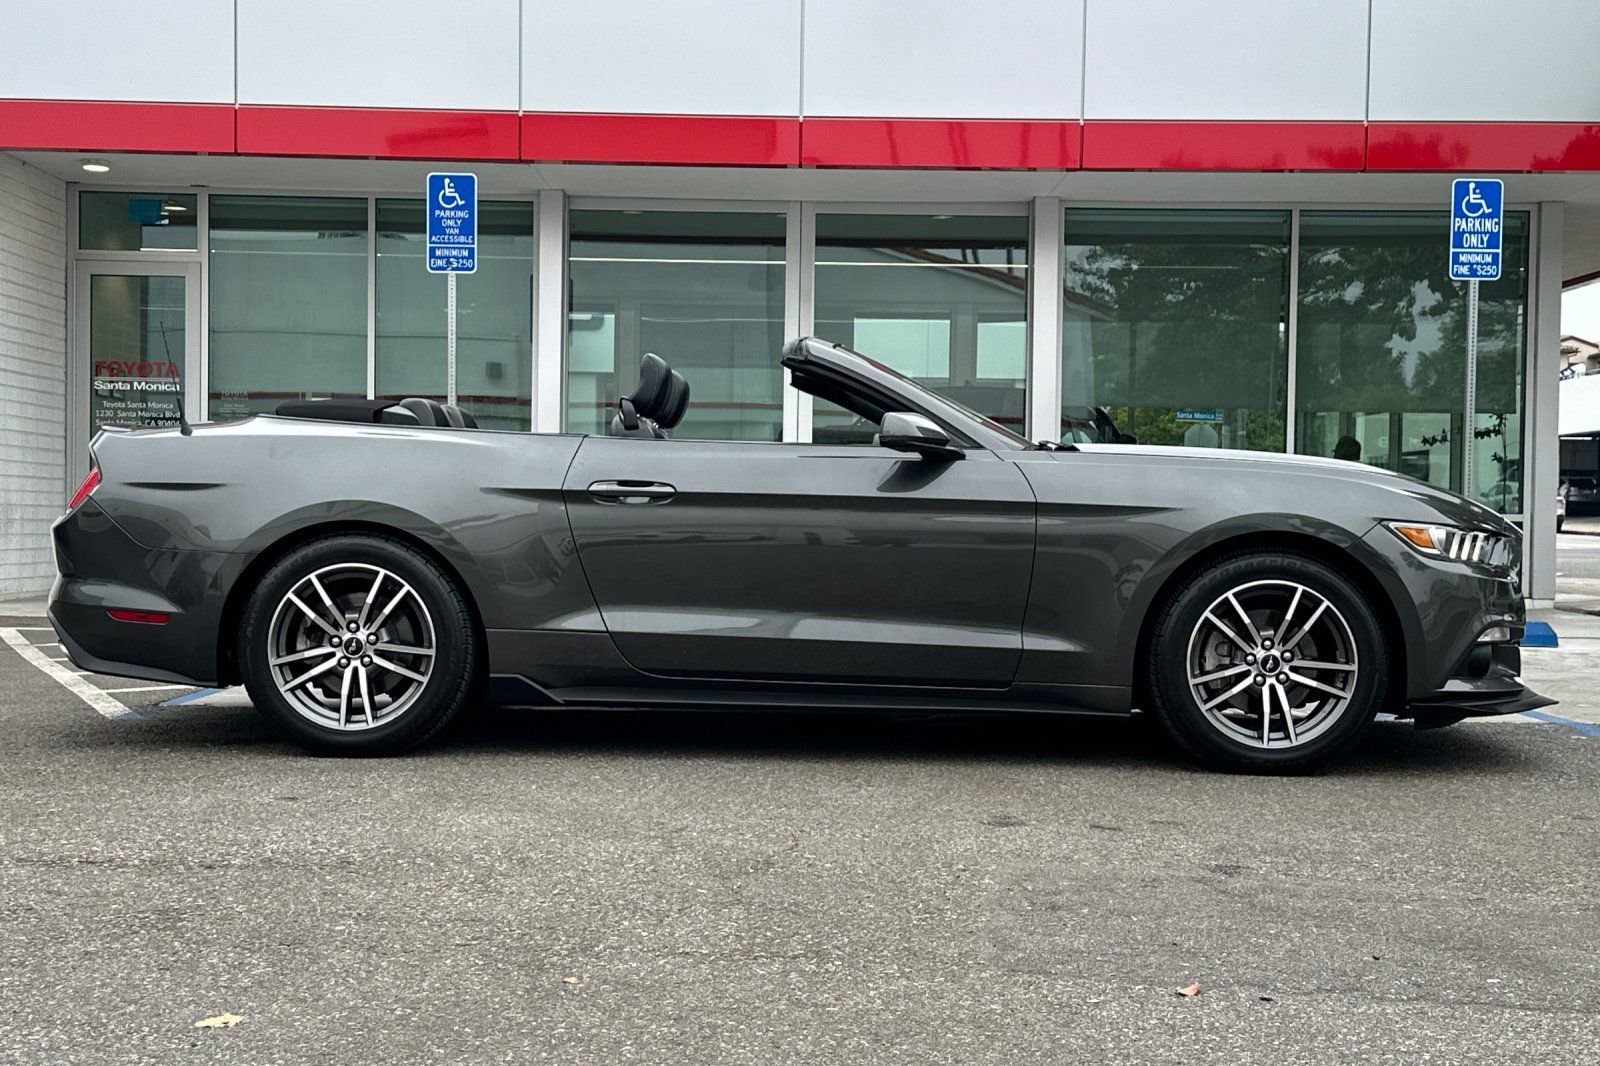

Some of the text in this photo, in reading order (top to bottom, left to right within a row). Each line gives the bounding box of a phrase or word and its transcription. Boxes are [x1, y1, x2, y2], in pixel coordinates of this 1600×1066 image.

[435, 209, 469, 218] PARKING
[441, 219, 462, 227] ONLY
[1454, 218, 1499, 232] PARKING
[431, 235, 473, 243] ACCESSIBLE
[1463, 233, 1489, 248] ONLY
[435, 248, 469, 257] MINIMUM
[1459, 253, 1492, 263] MINIMUM
[430, 259, 448, 268] FINE
[1453, 265, 1497, 275] FINE $250
[95, 360, 179, 377] TOYOTA
[93, 380, 180, 391] Santa Monica
[102, 401, 125, 409] Toyota
